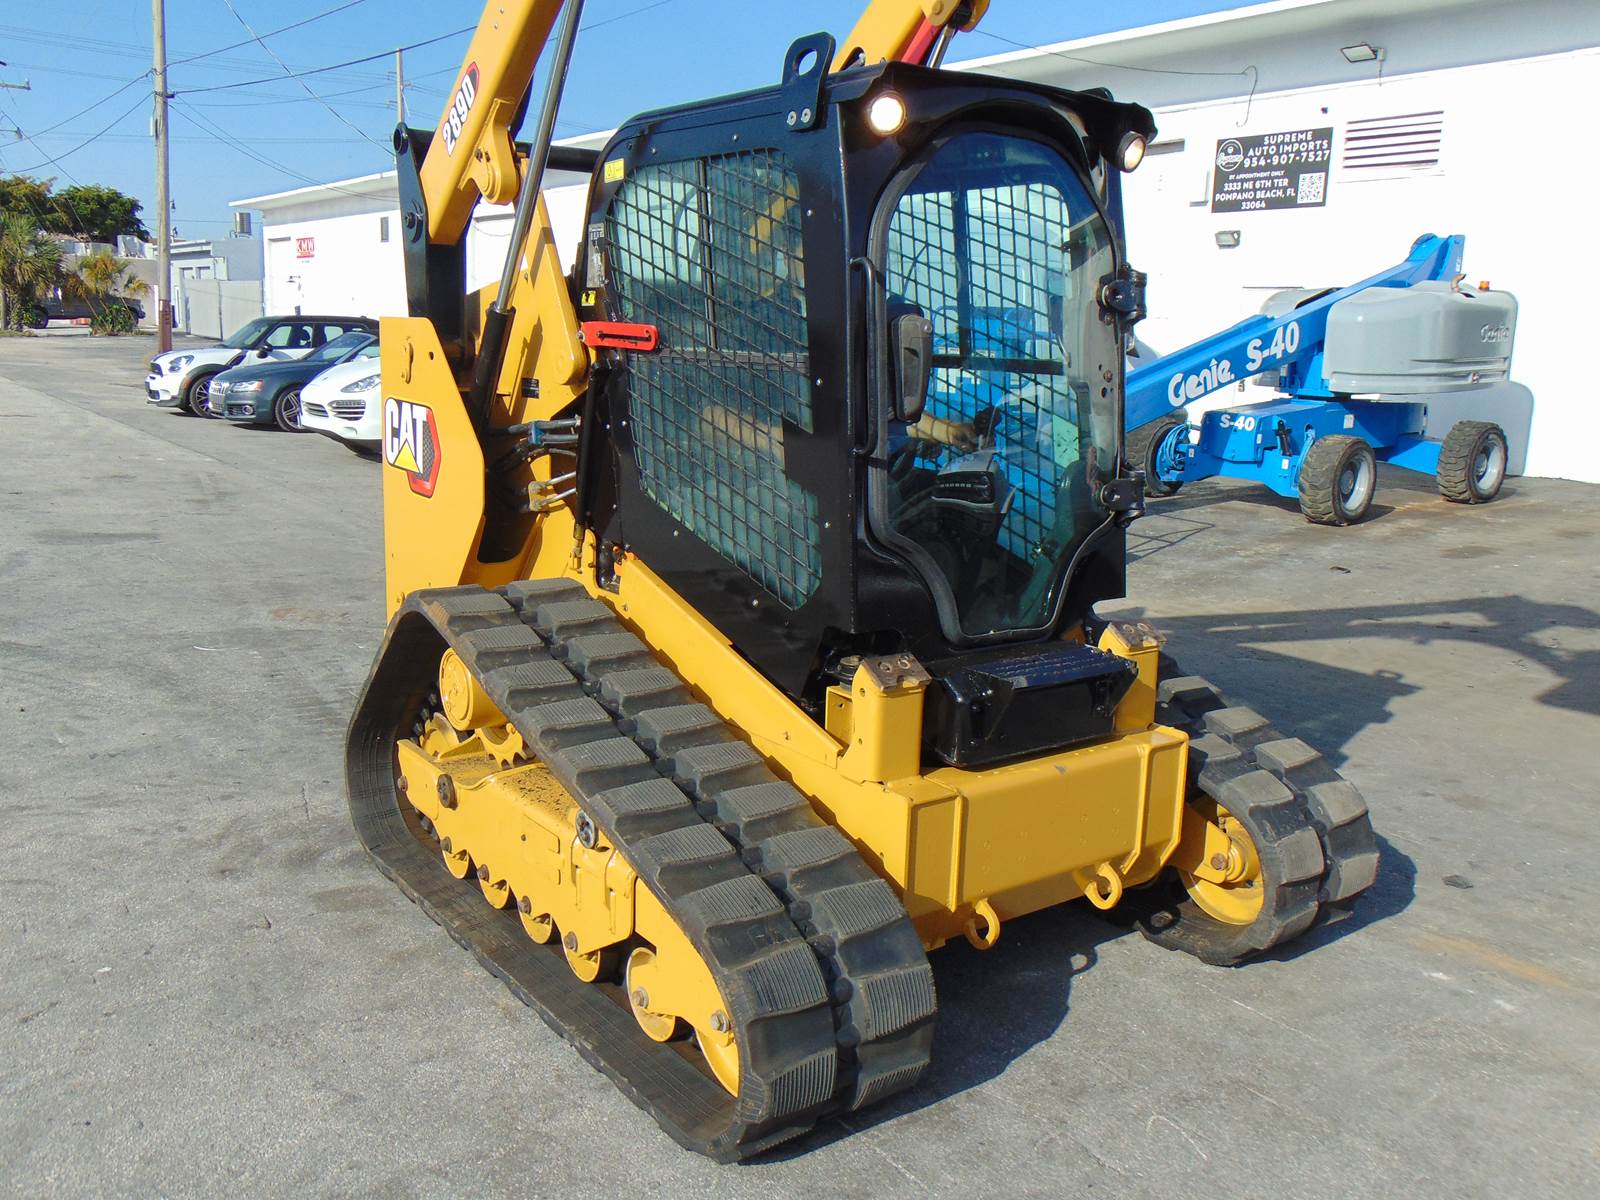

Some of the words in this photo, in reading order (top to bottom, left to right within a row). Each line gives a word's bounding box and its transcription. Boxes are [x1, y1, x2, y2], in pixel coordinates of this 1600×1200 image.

[443, 73, 475, 156] 289D
[1263, 131, 1313, 145] SUPREME
[1247, 145, 1277, 157] AUTO
[1279, 140, 1329, 154] IMPORTS
[1243, 150, 1331, 168] 954-907-7527
[1236, 171, 1271, 180] APPOINTMENT
[1223, 182, 1242, 191] 3333
[1243, 181, 1254, 190] NE
[1255, 179, 1272, 189] 6TH
[1273, 178, 1289, 187] TER
[1215, 190, 1255, 202] POMPANO
[1255, 188, 1285, 199] BEACH,
[1286, 188, 1296, 197] FL
[1241, 200, 1266, 210] 33064
[1167, 358, 1232, 407] Genie
[1246, 321, 1300, 372] S-40
[1219, 413, 1256, 432] S-40
[384, 397, 428, 475] CAT
